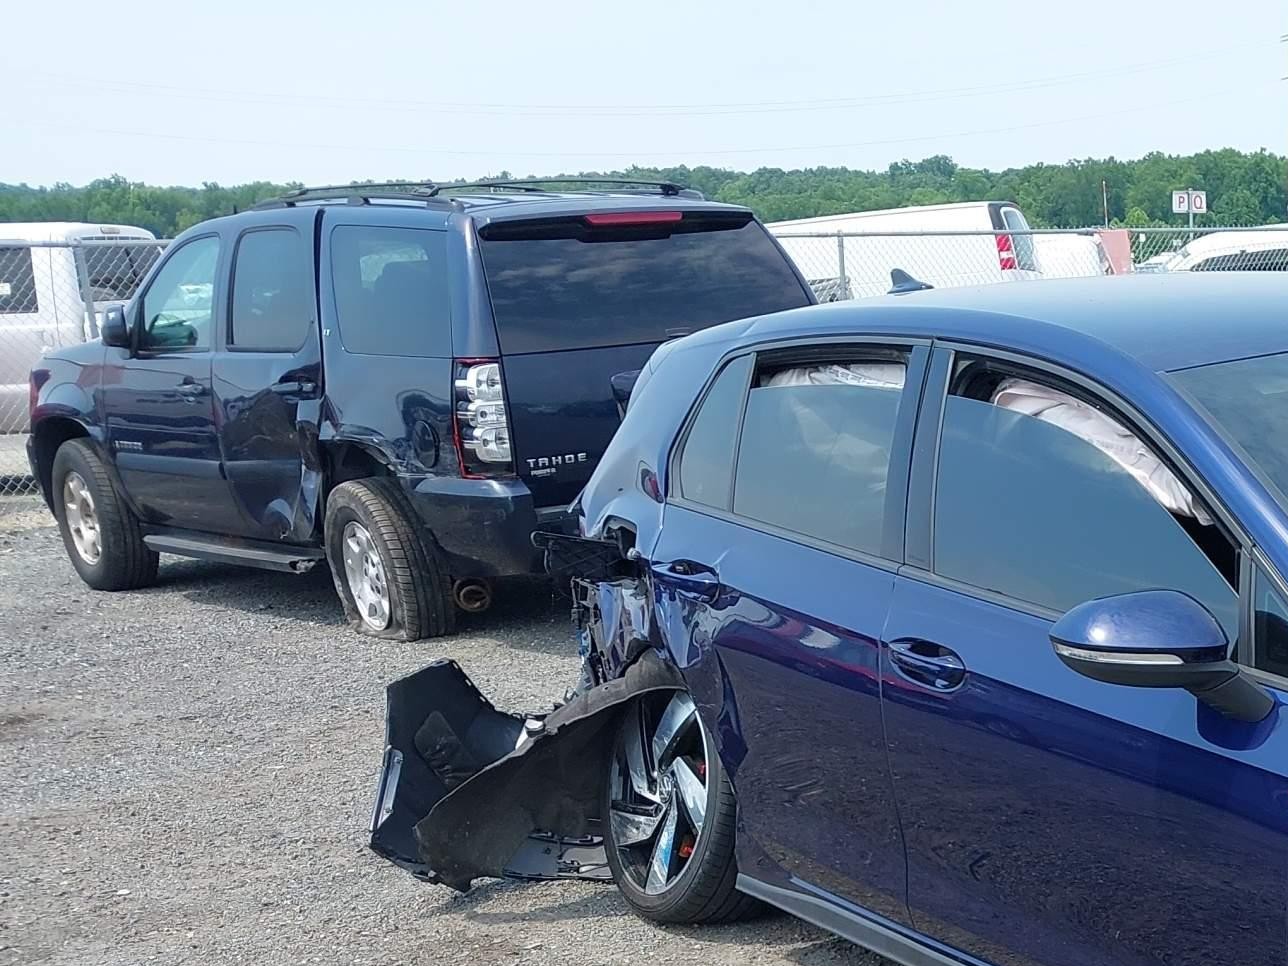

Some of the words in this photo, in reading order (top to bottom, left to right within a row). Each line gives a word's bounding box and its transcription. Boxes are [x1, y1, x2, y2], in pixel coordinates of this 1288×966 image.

[1178, 195, 1185, 208] P
[1193, 194, 1204, 209] Q
[526, 452, 587, 468] TAHOE
